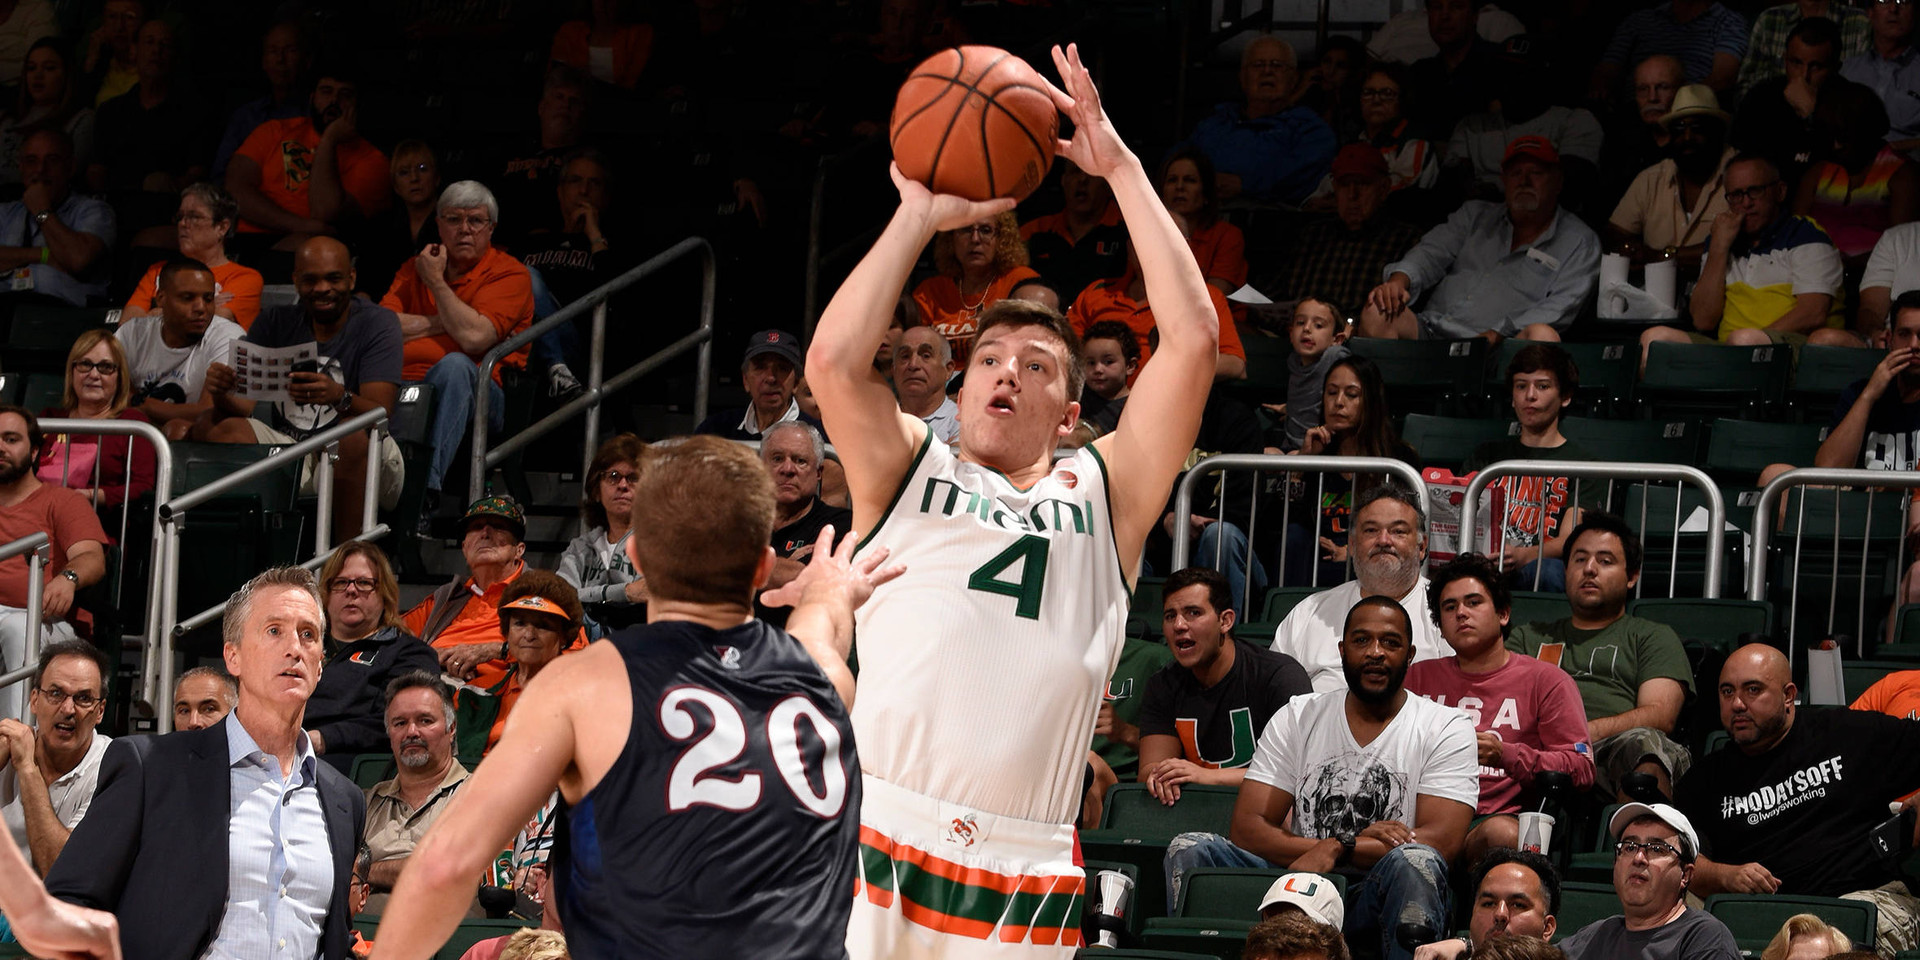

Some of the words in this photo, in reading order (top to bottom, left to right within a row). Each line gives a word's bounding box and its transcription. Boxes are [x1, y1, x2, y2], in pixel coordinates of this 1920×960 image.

[968, 534, 1050, 621] 4
[656, 683, 849, 820] 20
[1175, 706, 1257, 769] U
[1284, 878, 1317, 897] U
